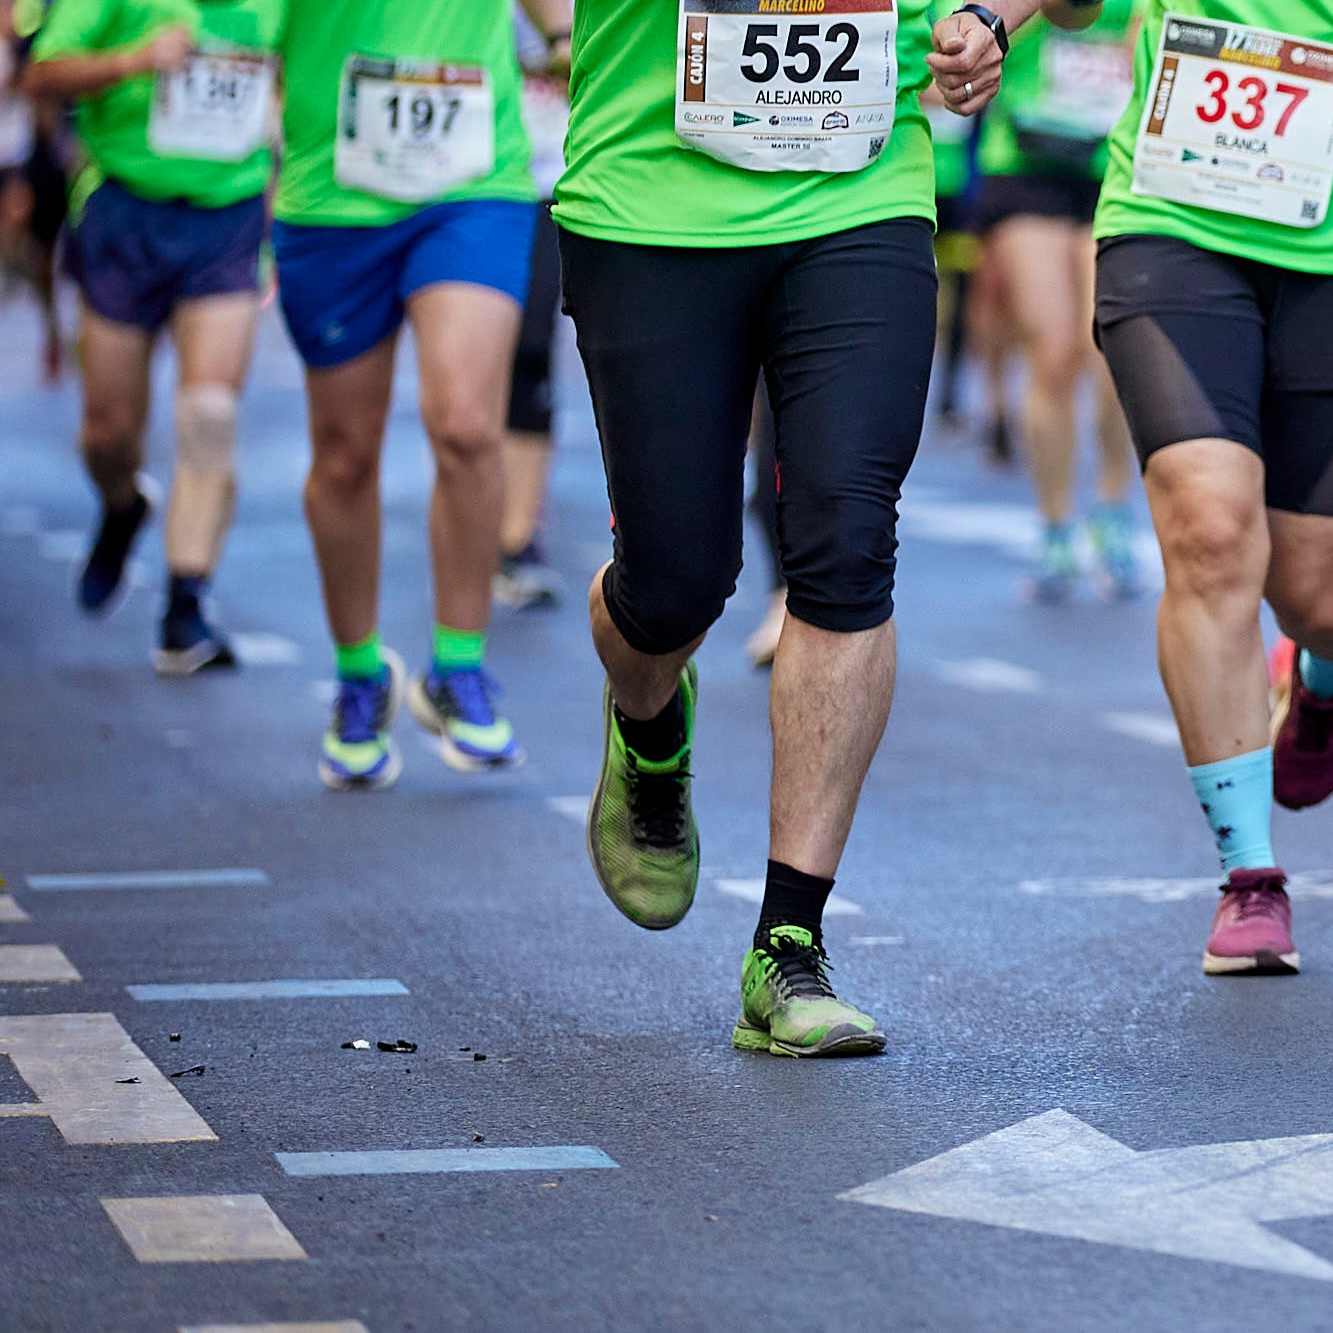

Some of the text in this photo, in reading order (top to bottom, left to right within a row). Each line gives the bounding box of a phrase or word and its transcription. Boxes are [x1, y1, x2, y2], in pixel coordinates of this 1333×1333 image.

[689, 31, 704, 85] CAJÓN 4
[740, 22, 860, 83] 552
[387, 94, 461, 136] 197
[686, 114, 724, 122] CALERO
[755, 90, 842, 105] ALEJANDRO
[1196, 70, 1309, 137] 337
[1214, 131, 1269, 155] BLANCA
